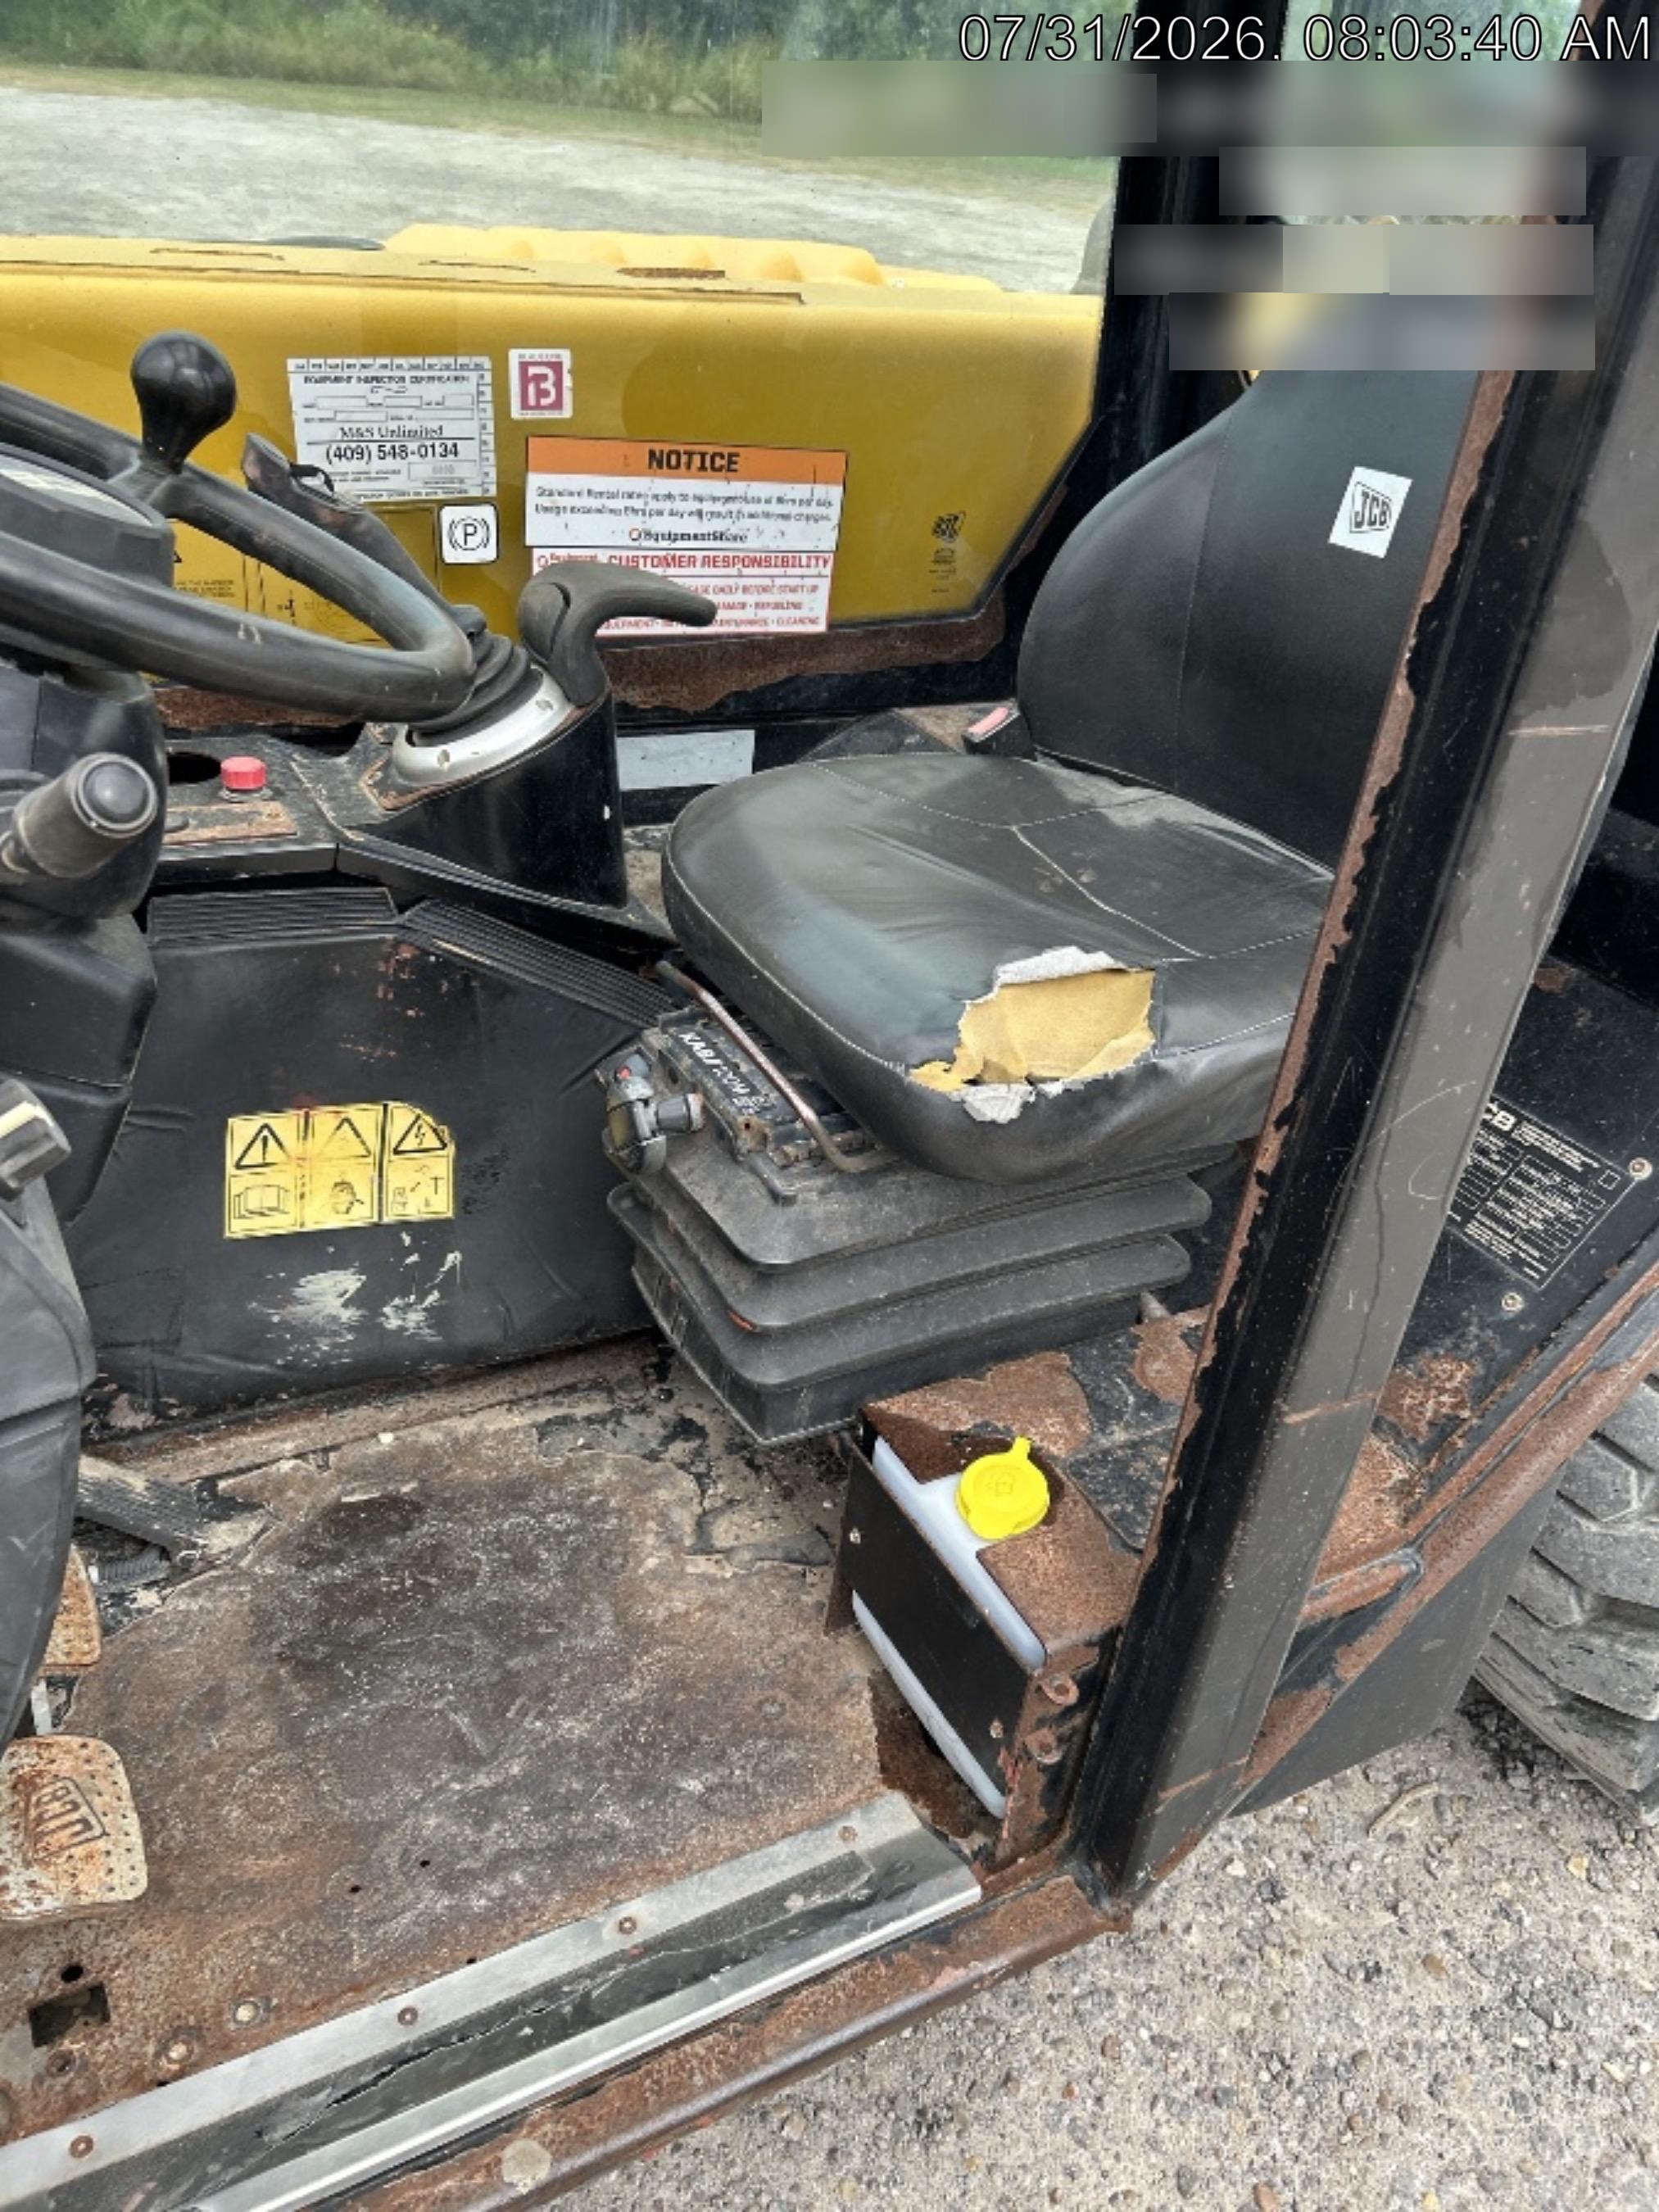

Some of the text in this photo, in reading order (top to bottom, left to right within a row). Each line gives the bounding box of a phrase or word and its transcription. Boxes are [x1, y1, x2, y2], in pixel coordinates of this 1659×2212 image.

[378, 424, 443, 438] Unlimited
[326, 442, 459, 465] (409) 548-0134
[647, 448, 741, 473] NOTICE
[1353, 489, 1389, 528] JCB
[608, 555, 696, 569] CUSTOMER
[700, 555, 831, 569] RESPONSIBILITY
